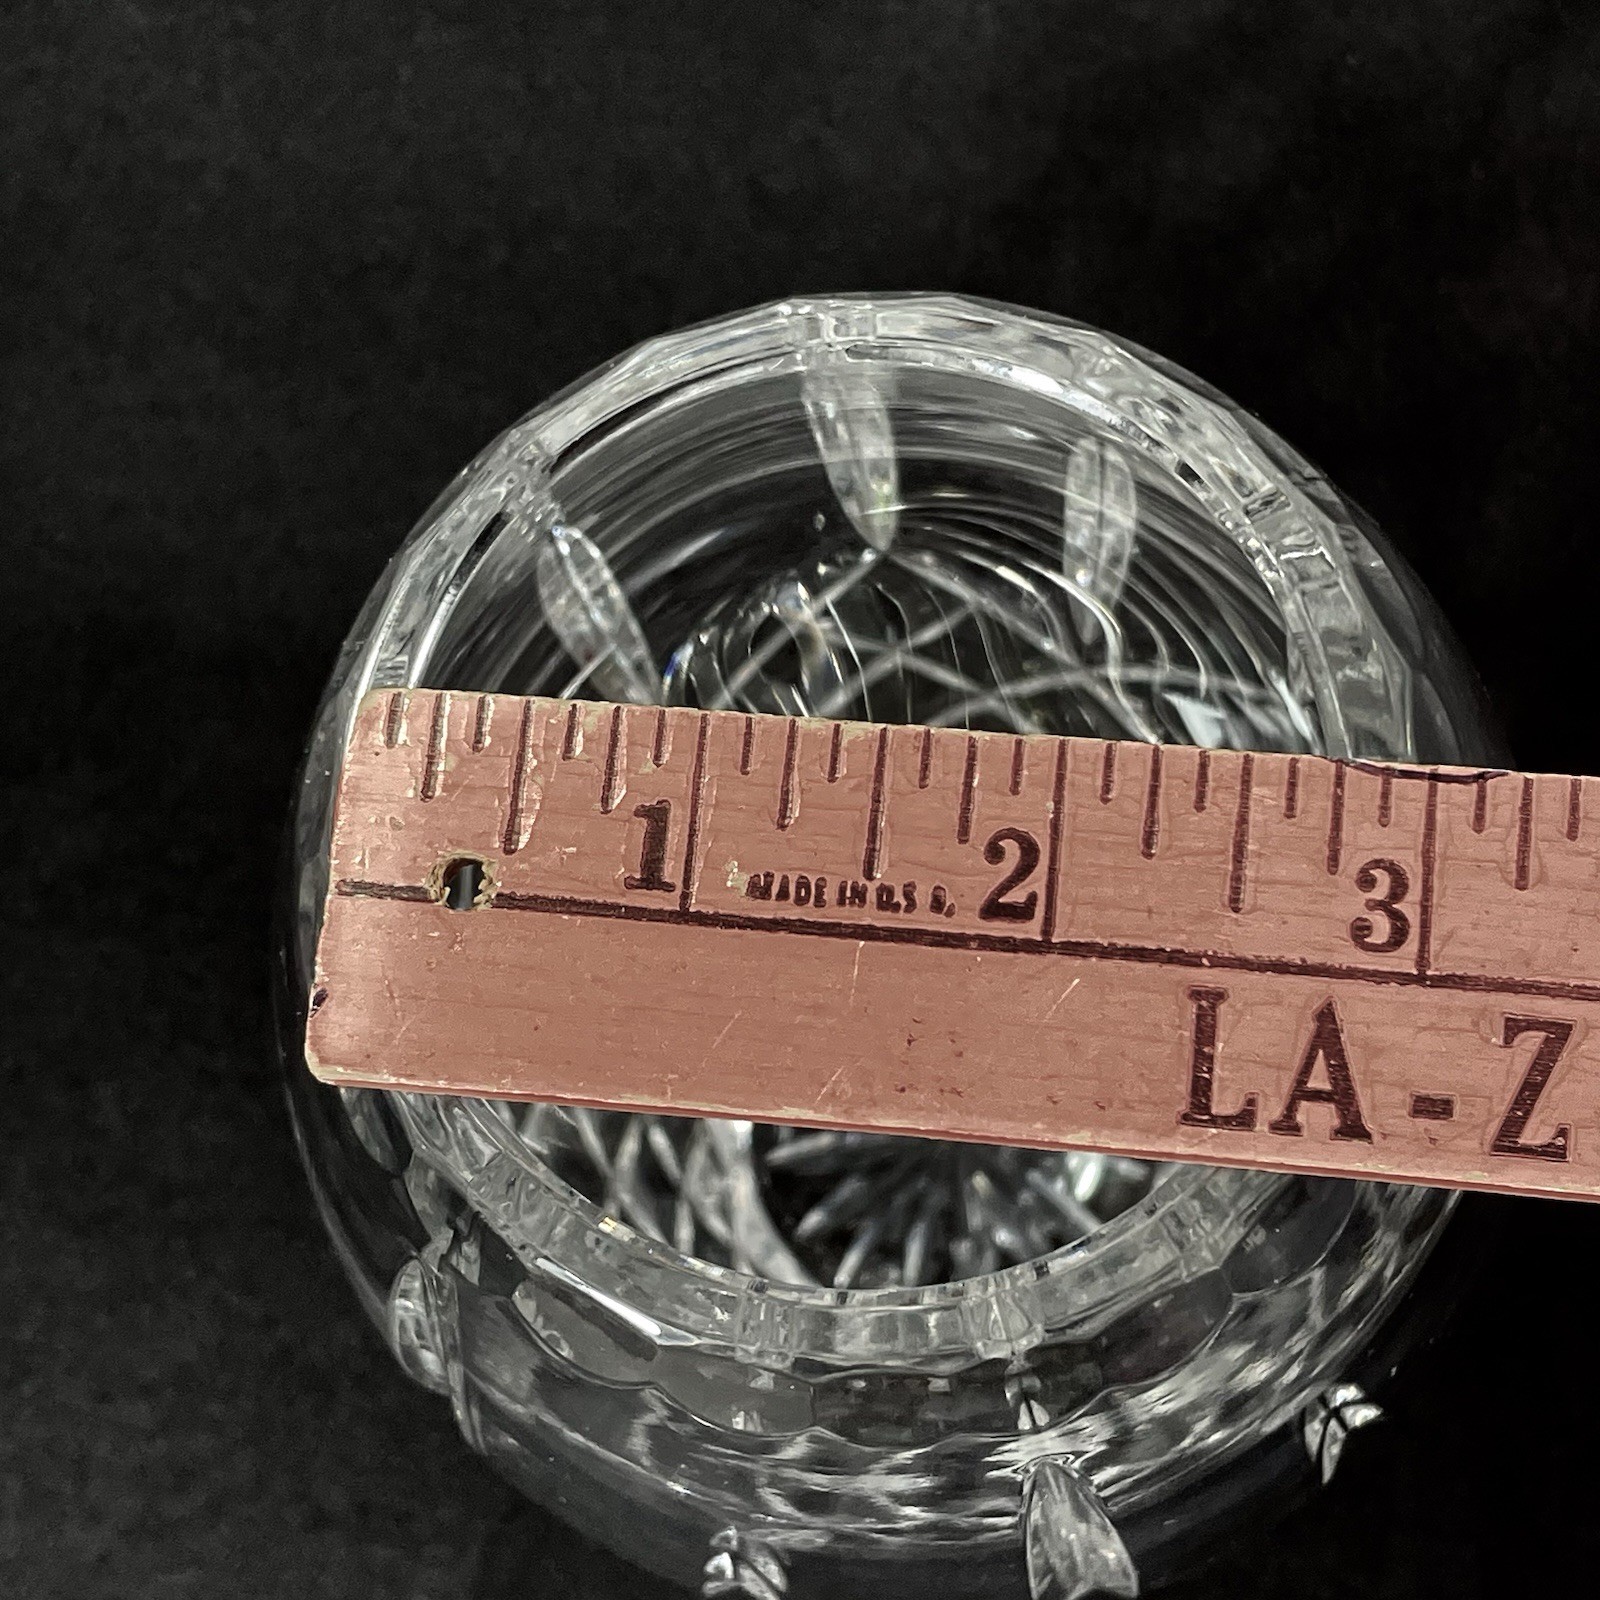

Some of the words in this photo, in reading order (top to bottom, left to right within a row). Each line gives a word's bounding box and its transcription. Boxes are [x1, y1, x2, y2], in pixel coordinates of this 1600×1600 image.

[624, 799, 676, 892] 1
[746, 870, 827, 908] MADE
[837, 880, 868, 908] IN
[978, 827, 1041, 922] 2
[1350, 858, 1410, 953] 3
